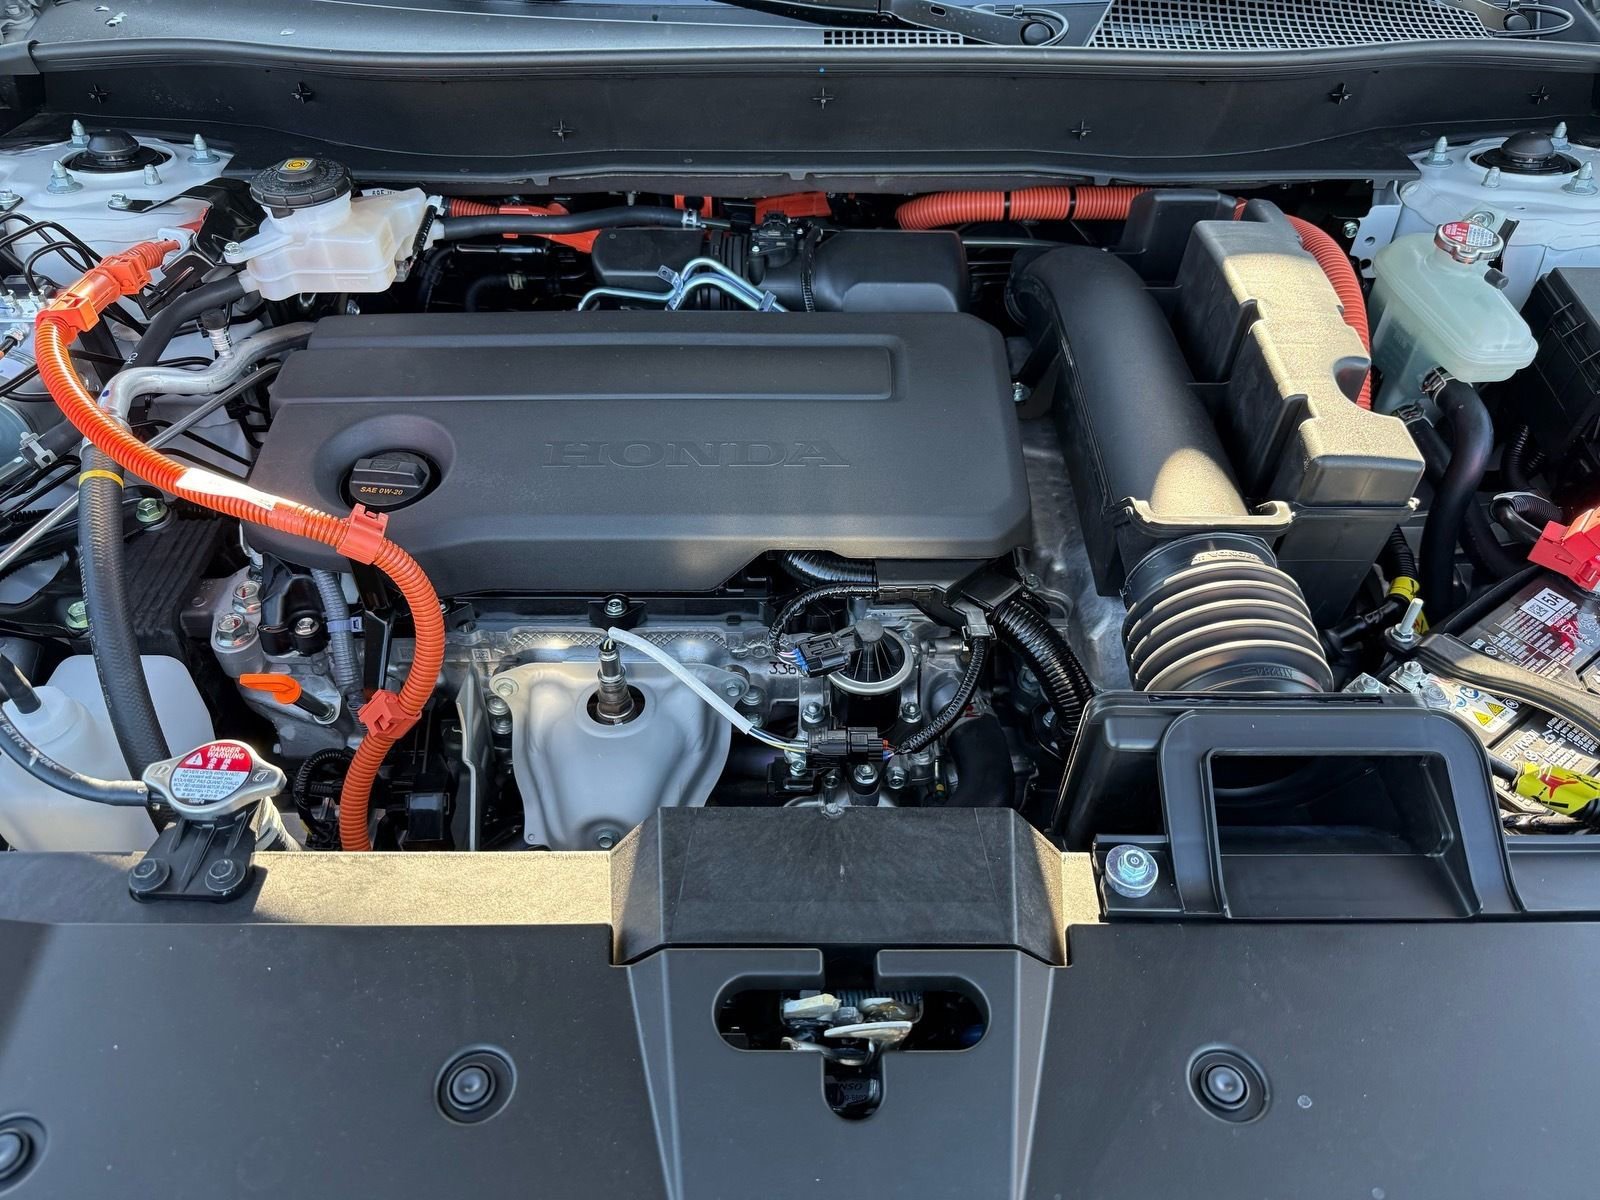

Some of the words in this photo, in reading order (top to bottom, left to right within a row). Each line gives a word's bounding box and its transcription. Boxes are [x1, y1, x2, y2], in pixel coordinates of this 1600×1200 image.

[542, 440, 849, 468] HONDA
[360, 486, 378, 494] SAE
[378, 487, 404, 496] 0W-20
[1541, 592, 1563, 606] 5A
[209, 745, 241, 753] DANGER
[207, 751, 245, 760] WARNUNG
